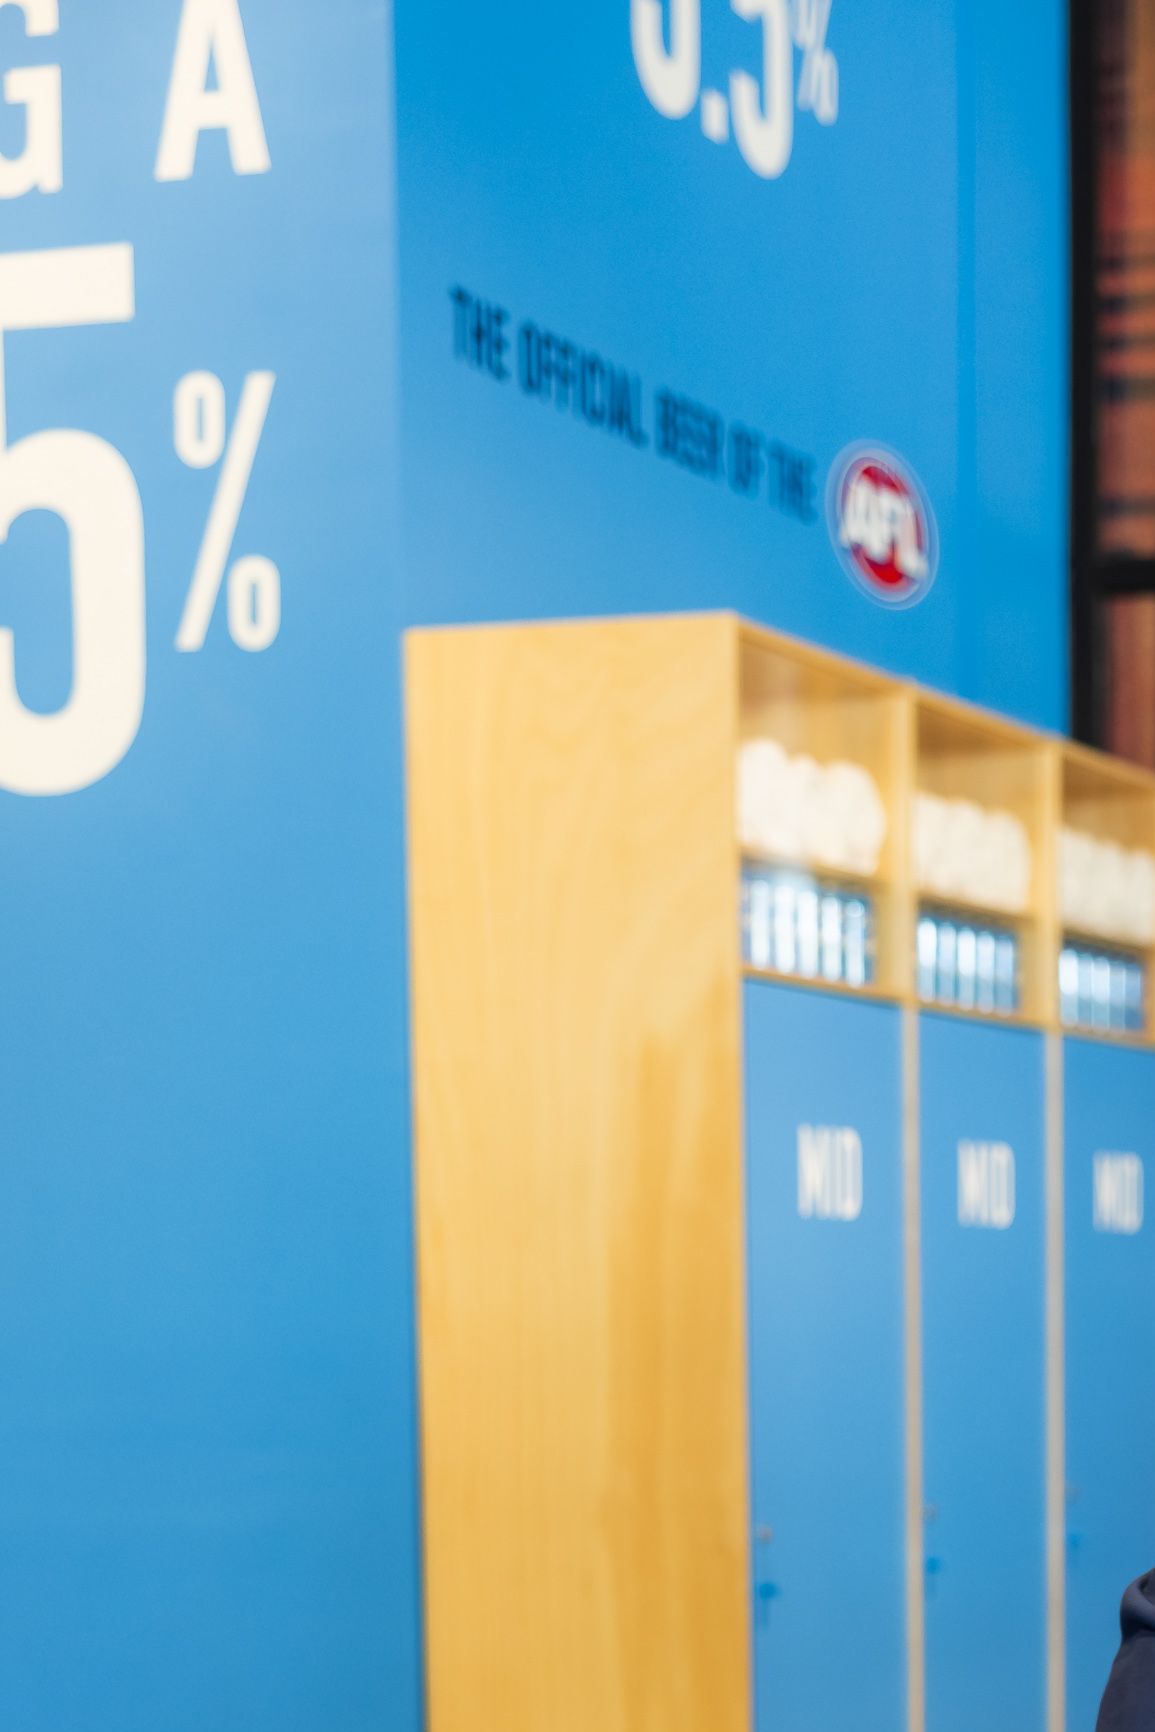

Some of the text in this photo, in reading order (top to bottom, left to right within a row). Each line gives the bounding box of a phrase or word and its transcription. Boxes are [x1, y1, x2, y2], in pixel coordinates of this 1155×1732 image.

[450, 285, 819, 525] THE OFFICIAL BEER OF THE
[840, 475, 928, 580] AFL
